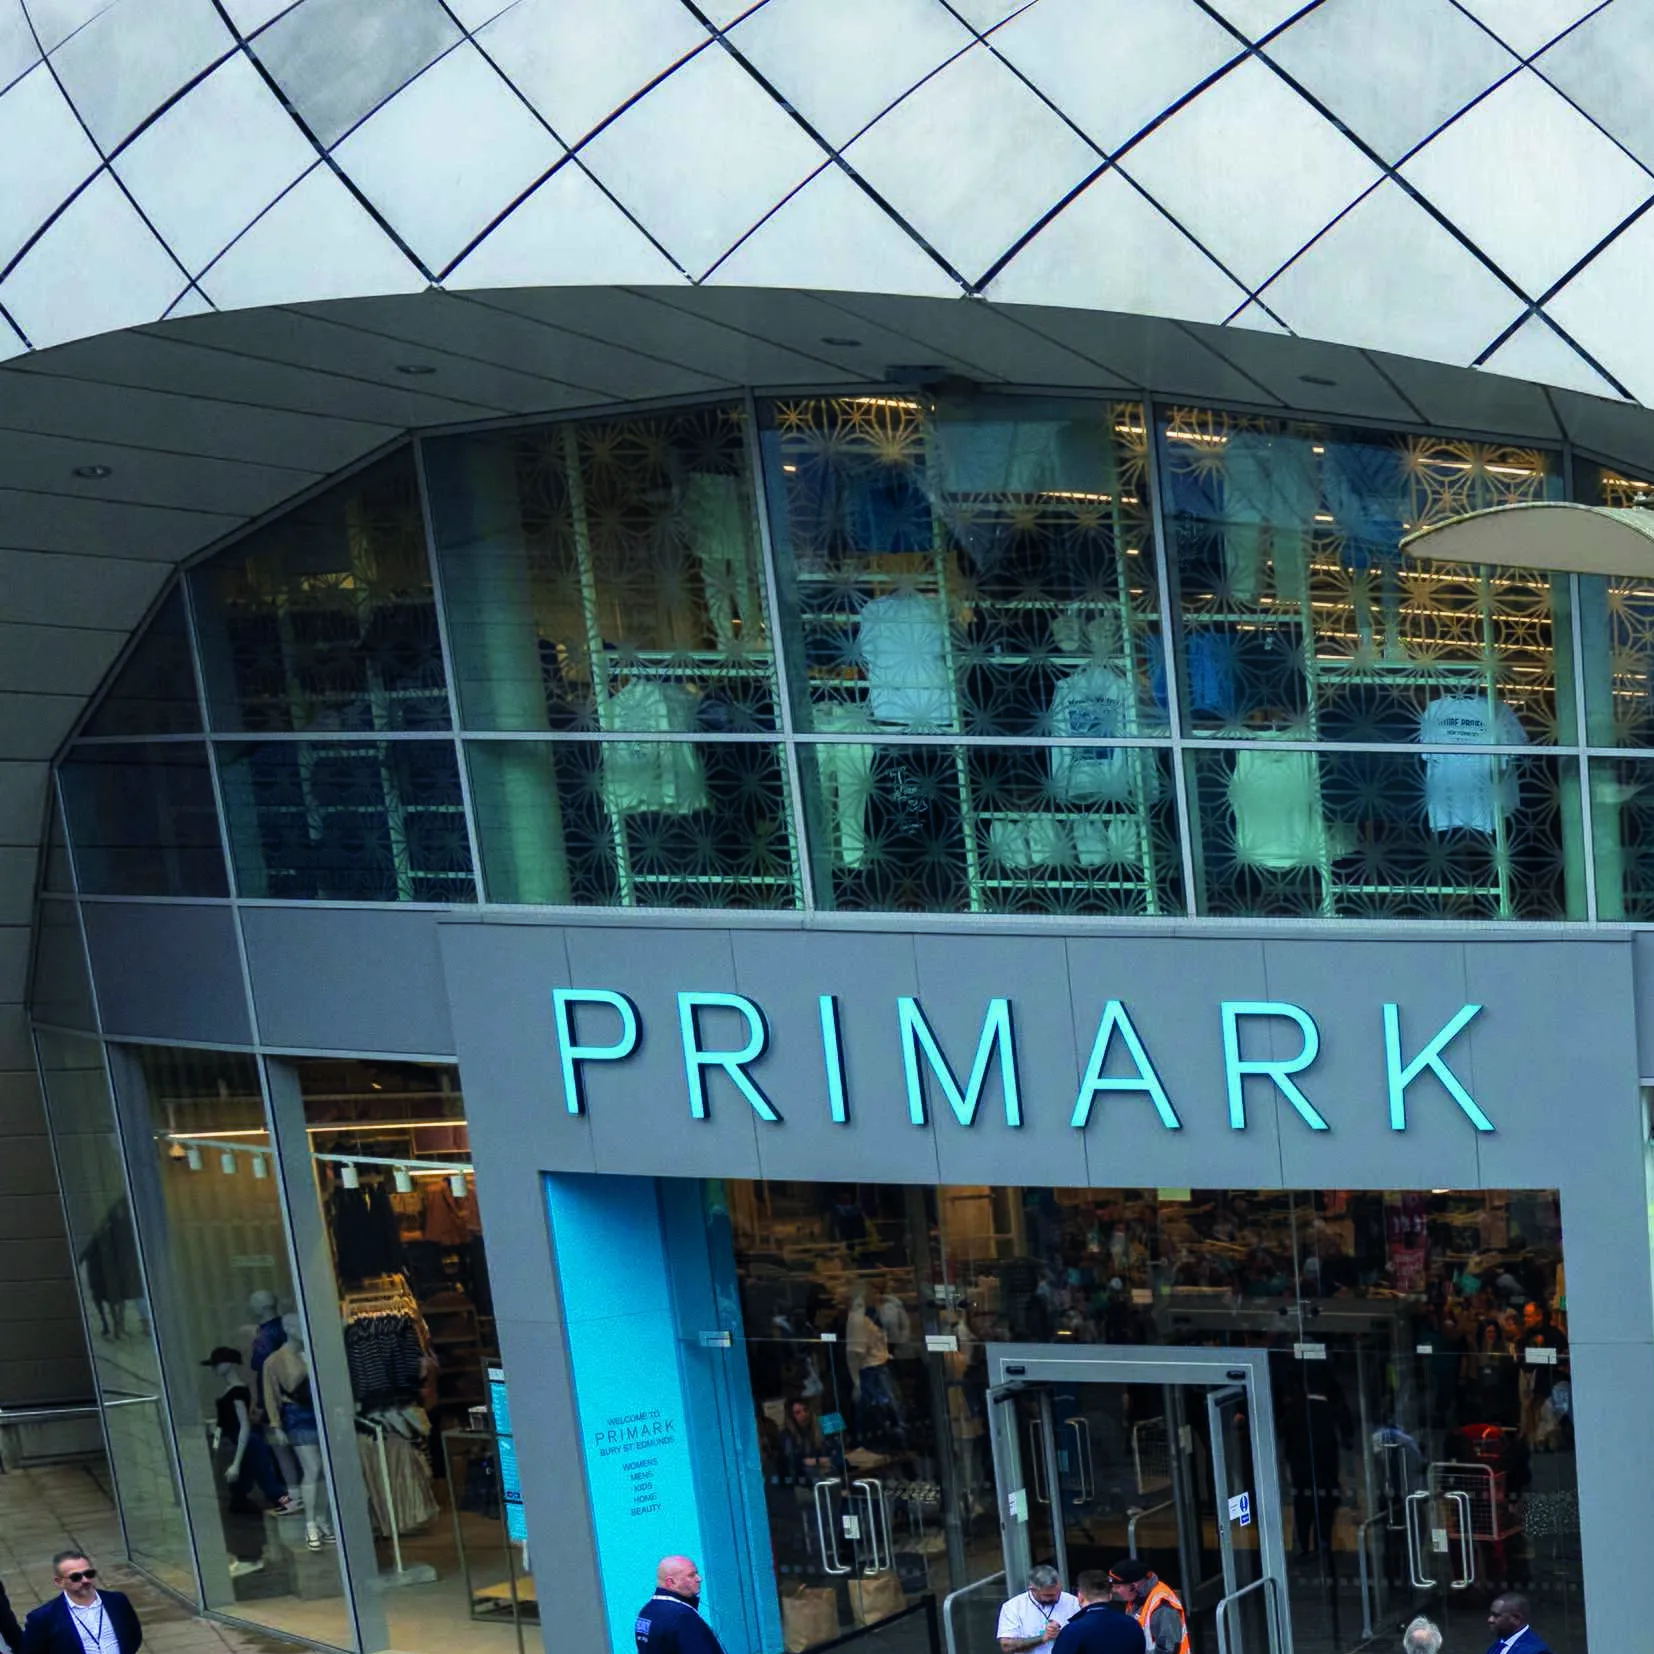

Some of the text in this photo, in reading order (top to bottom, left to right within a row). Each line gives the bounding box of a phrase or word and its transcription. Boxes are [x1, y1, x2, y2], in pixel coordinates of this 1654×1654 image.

[552, 987, 1496, 1134] PRIMARK
[608, 1409, 661, 1426] WELCOME TO
[596, 1420, 675, 1446] PRIMARK
[600, 1446, 621, 1457] BURY
[636, 1437, 674, 1450] EDMUNDS
[623, 1458, 657, 1471] WOMENS
[631, 1472, 654, 1481] MENS
[634, 1482, 653, 1492] KIDS
[633, 1493, 657, 1504] HOME
[631, 1504, 662, 1516] BEAUTY
